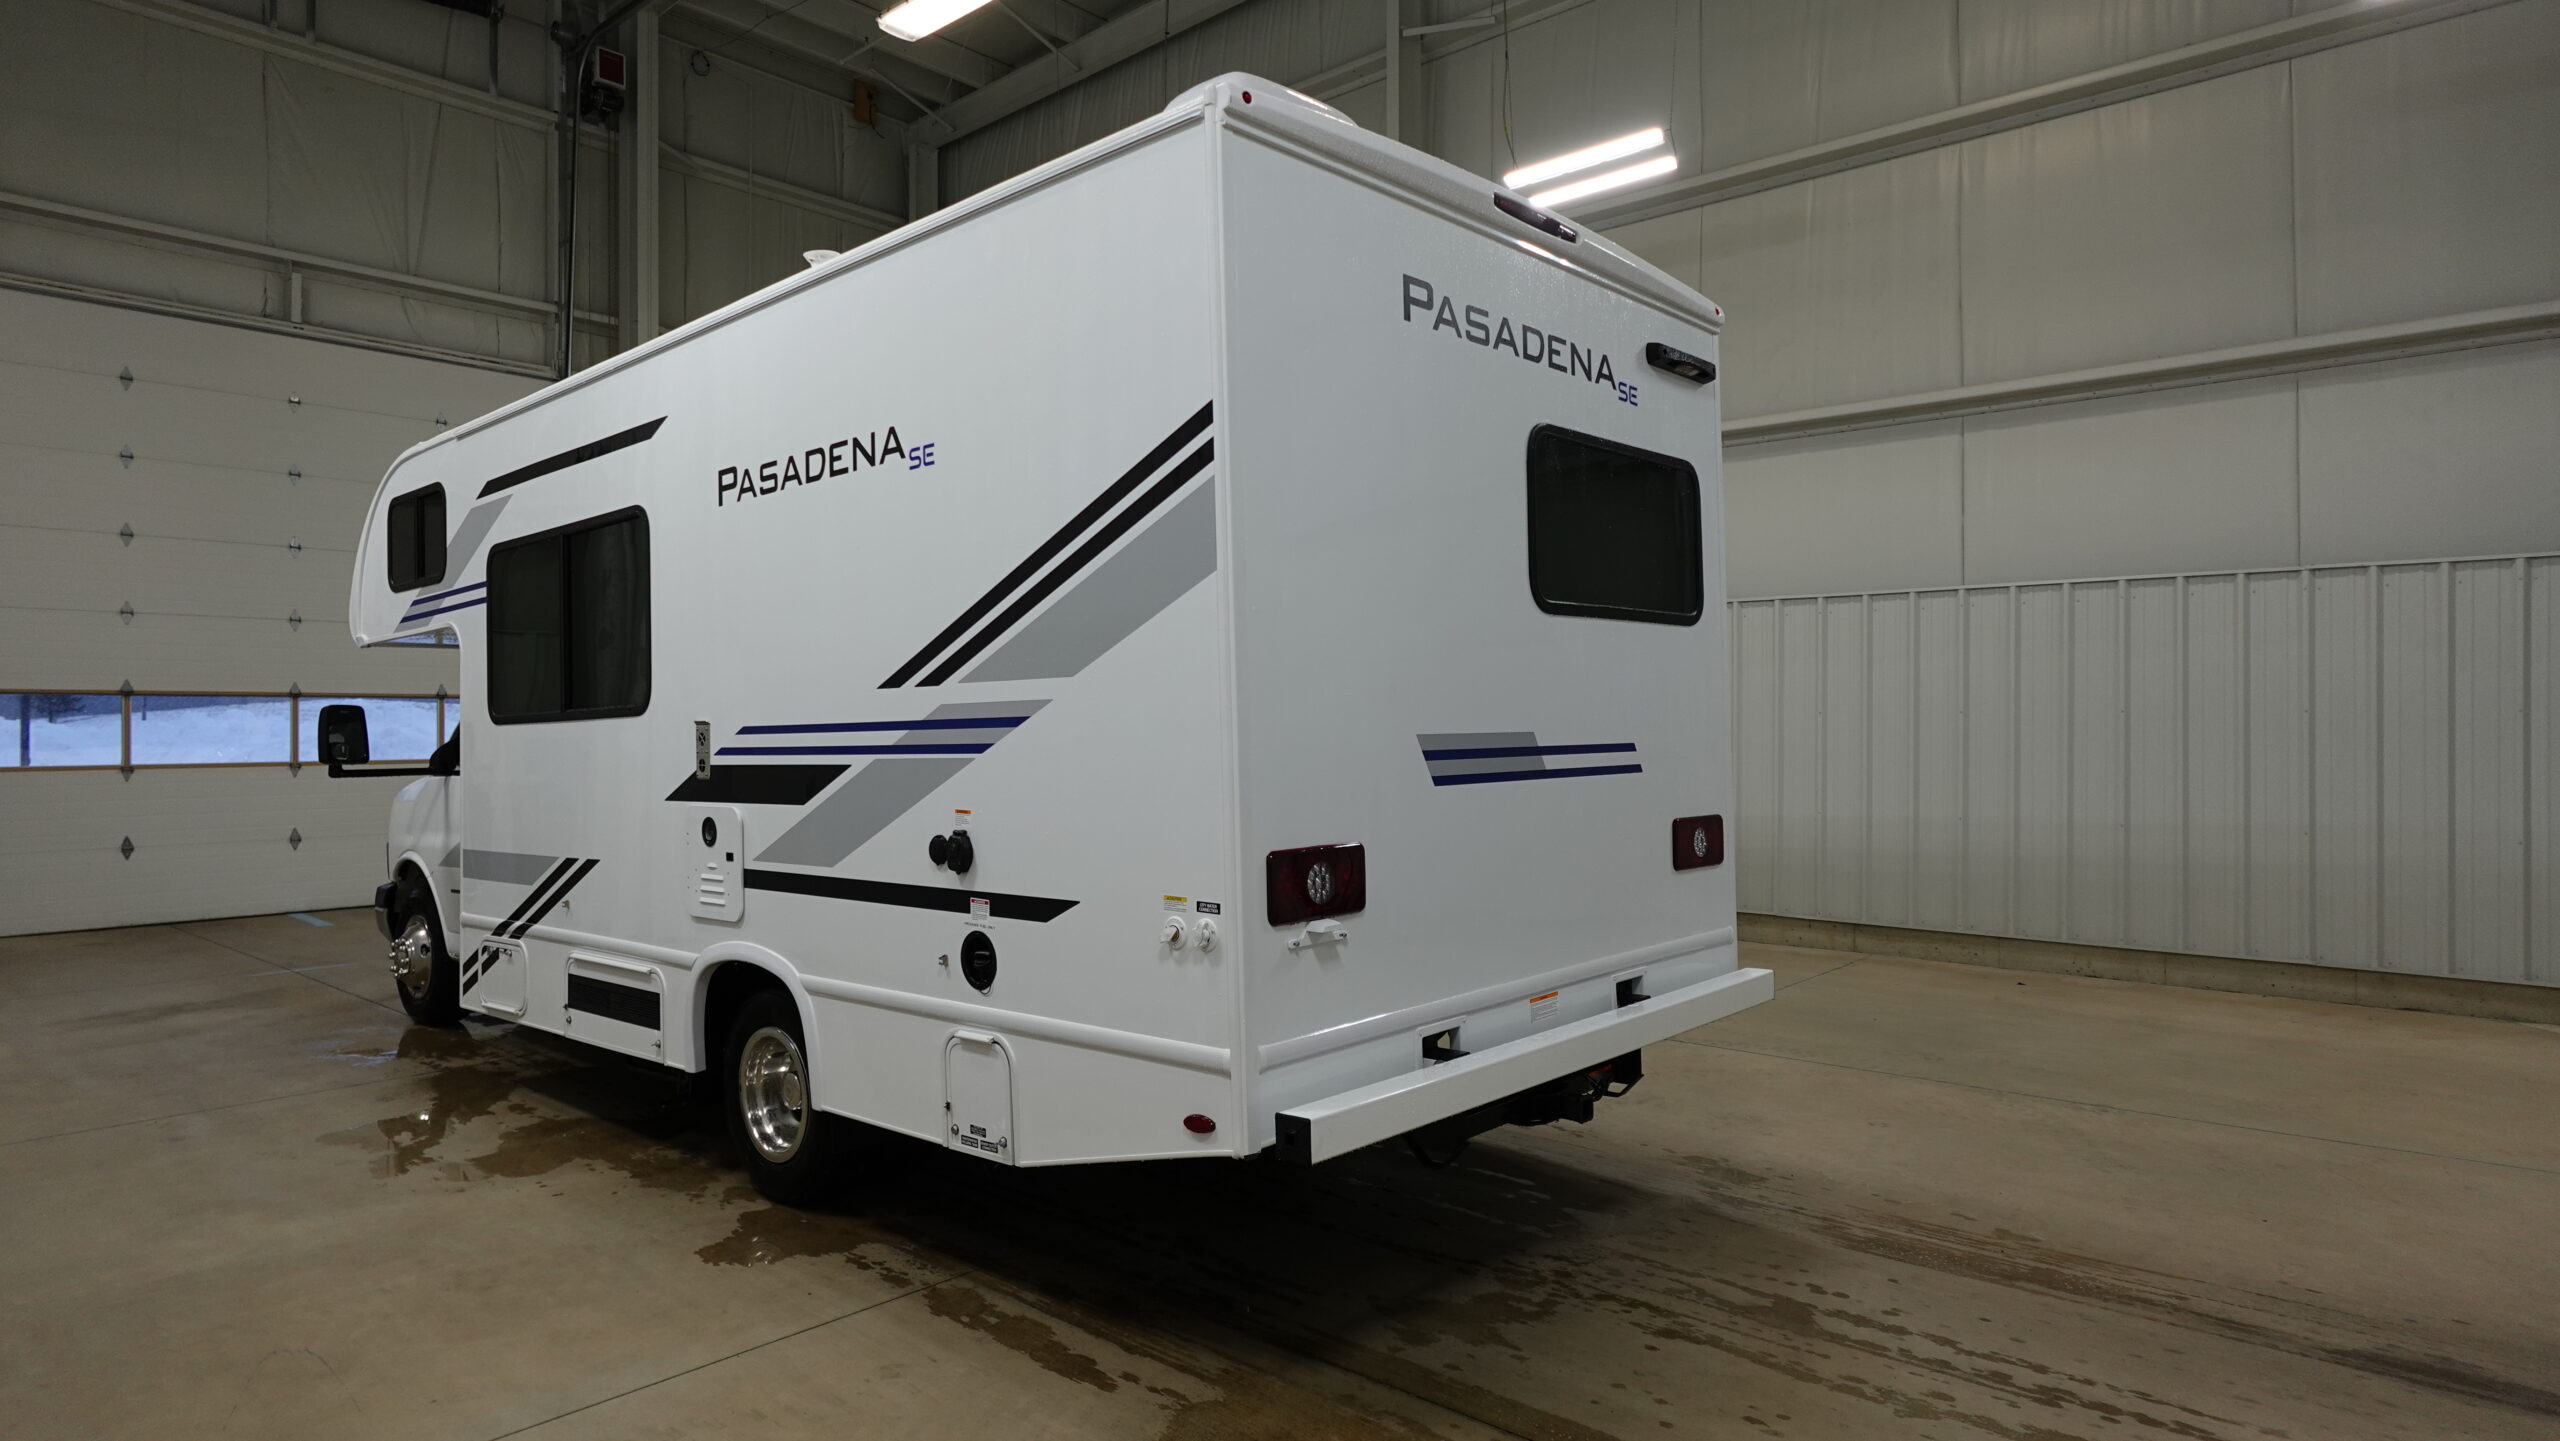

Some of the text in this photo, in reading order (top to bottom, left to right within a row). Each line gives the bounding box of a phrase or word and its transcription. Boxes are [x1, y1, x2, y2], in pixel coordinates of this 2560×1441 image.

[1402, 273, 1638, 407] PASADENA SE
[717, 426, 935, 507] PASADENA SE
